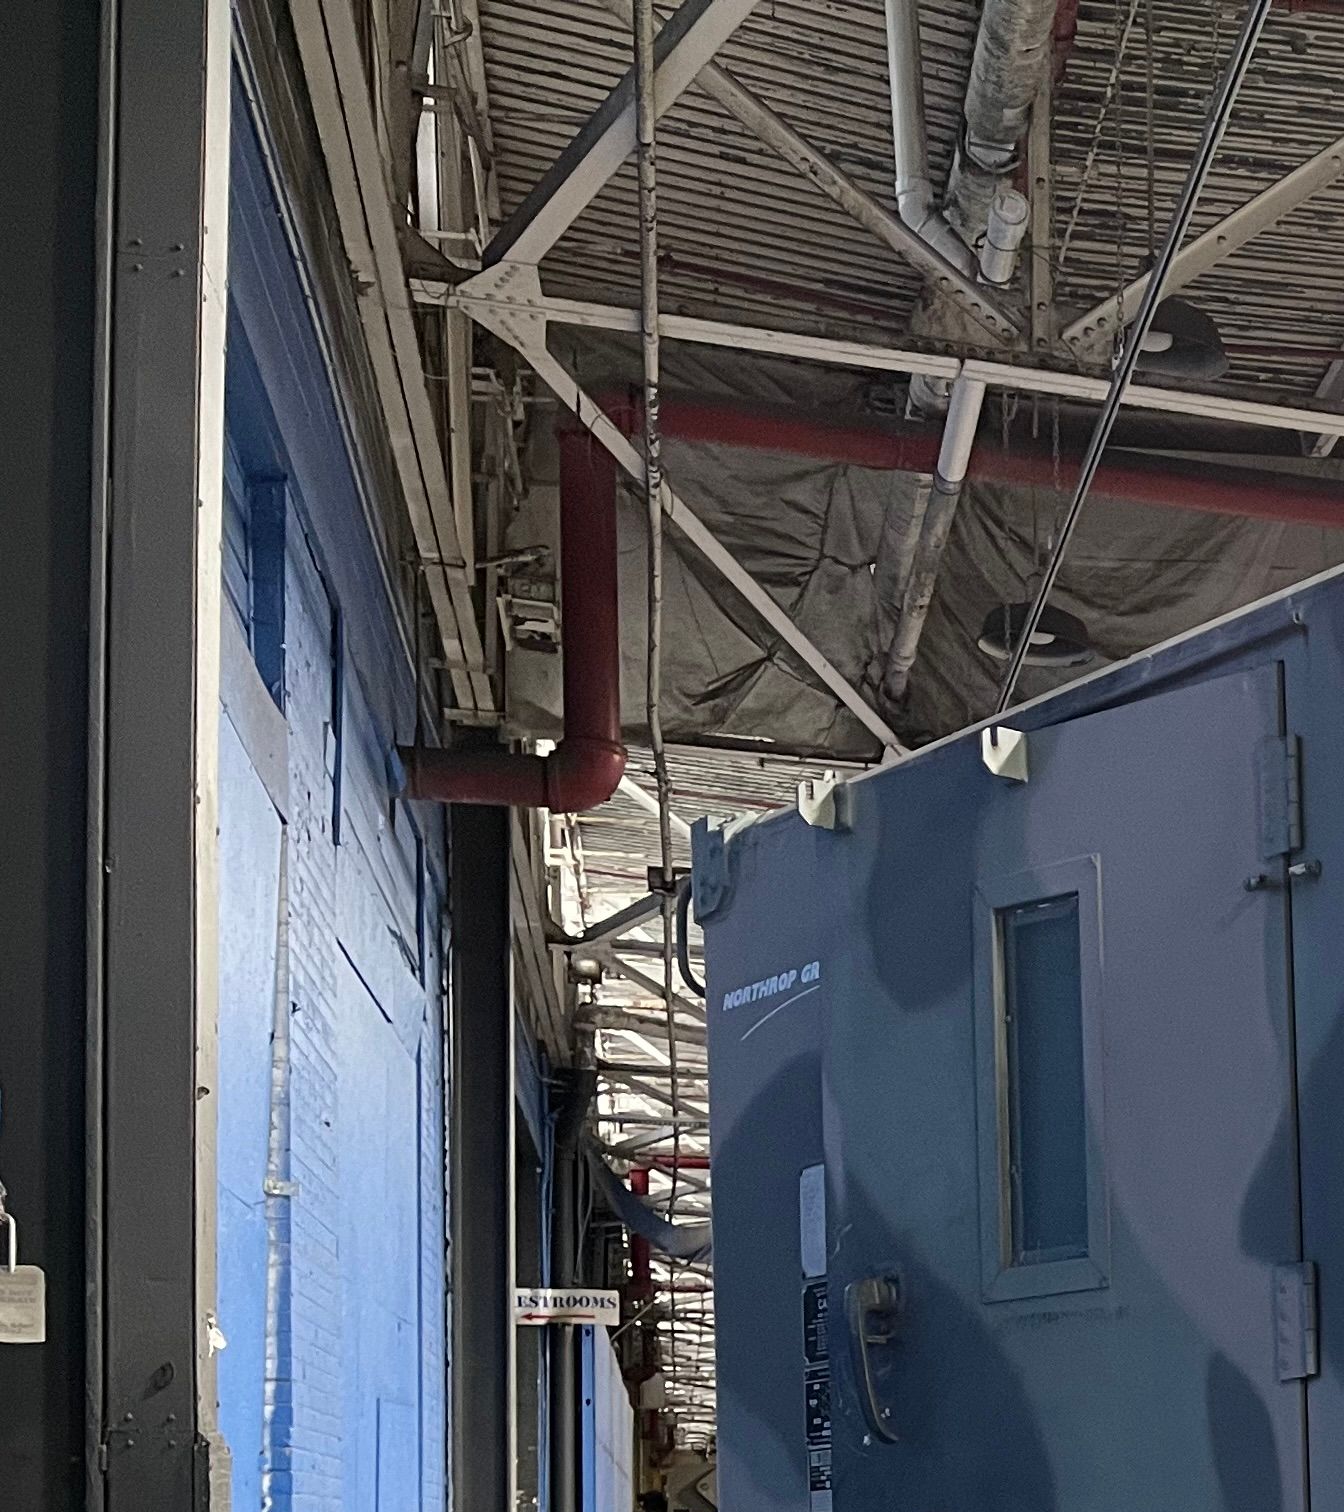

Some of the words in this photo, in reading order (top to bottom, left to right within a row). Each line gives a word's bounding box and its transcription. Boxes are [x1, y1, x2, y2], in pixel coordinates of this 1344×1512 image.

[722, 969, 798, 1012] NORTHROP
[800, 960, 820, 983] GR
[515, 1294, 617, 1310] ESTROOMS
